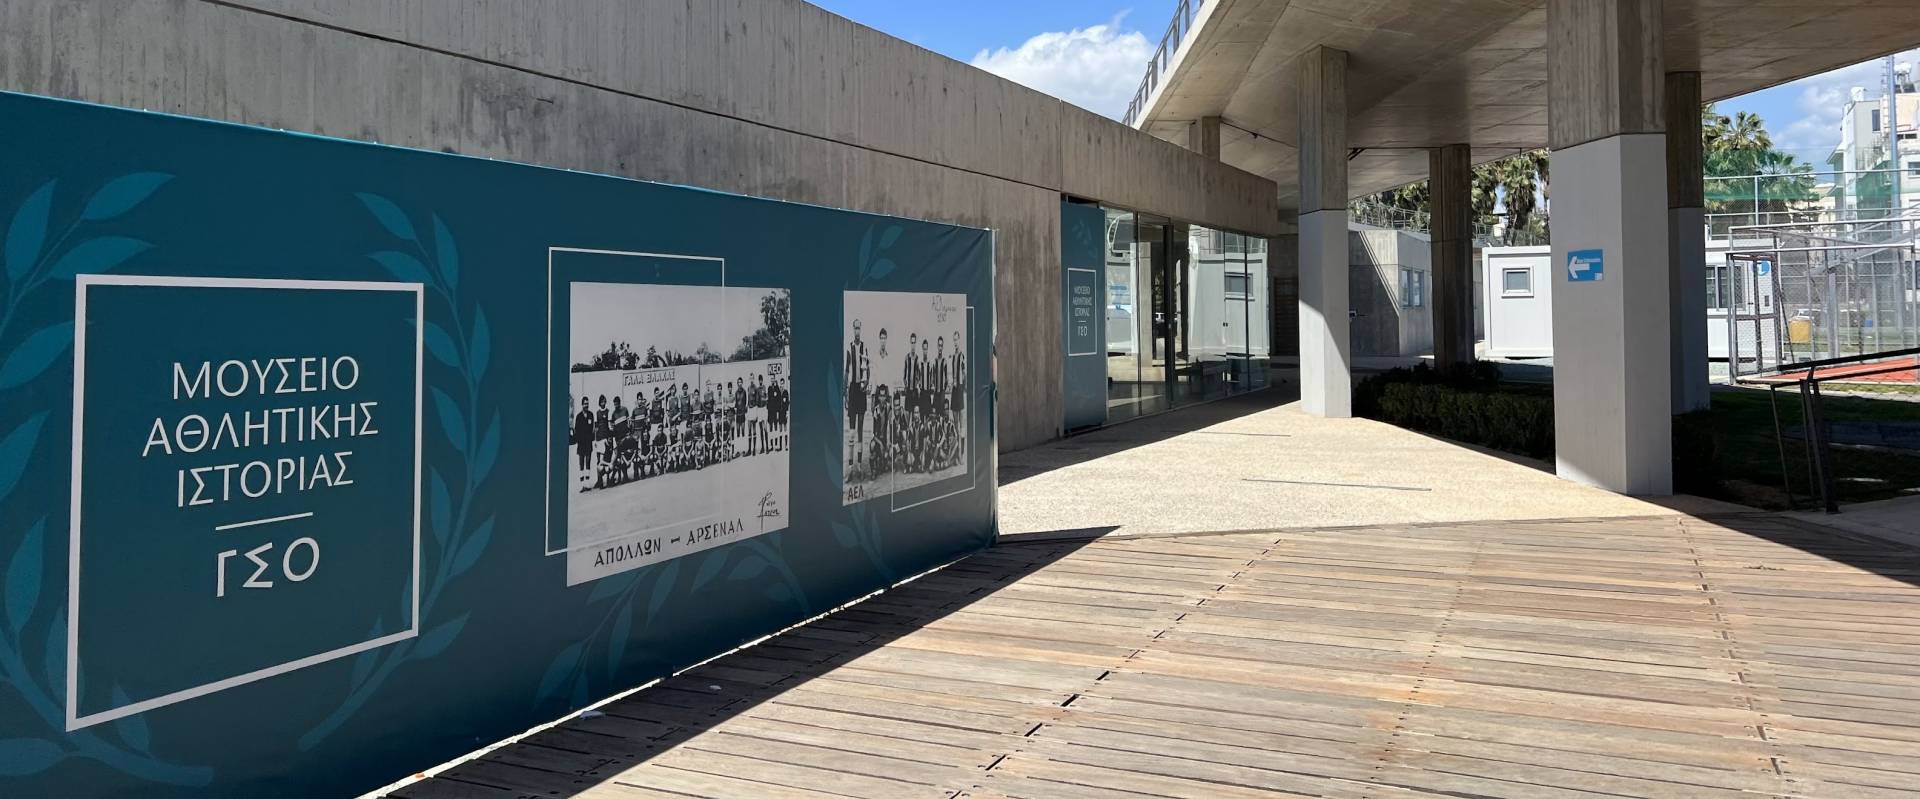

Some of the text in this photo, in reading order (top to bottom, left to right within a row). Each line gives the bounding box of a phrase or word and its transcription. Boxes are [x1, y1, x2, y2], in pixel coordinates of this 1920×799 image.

[173, 356, 359, 400] ΜΟΥΣΕΙΟ
[142, 401, 378, 457] ΑΘΛΗΤΙΚΗΣ
[178, 451, 354, 508] ΙΣΤΟΡΙΑΣ
[217, 537, 320, 597] ΓΣΟ
[594, 537, 661, 568] ΑΠΟΛΛΩΝ
[686, 517, 744, 546] ΑΡΣΕΝΑΛ
